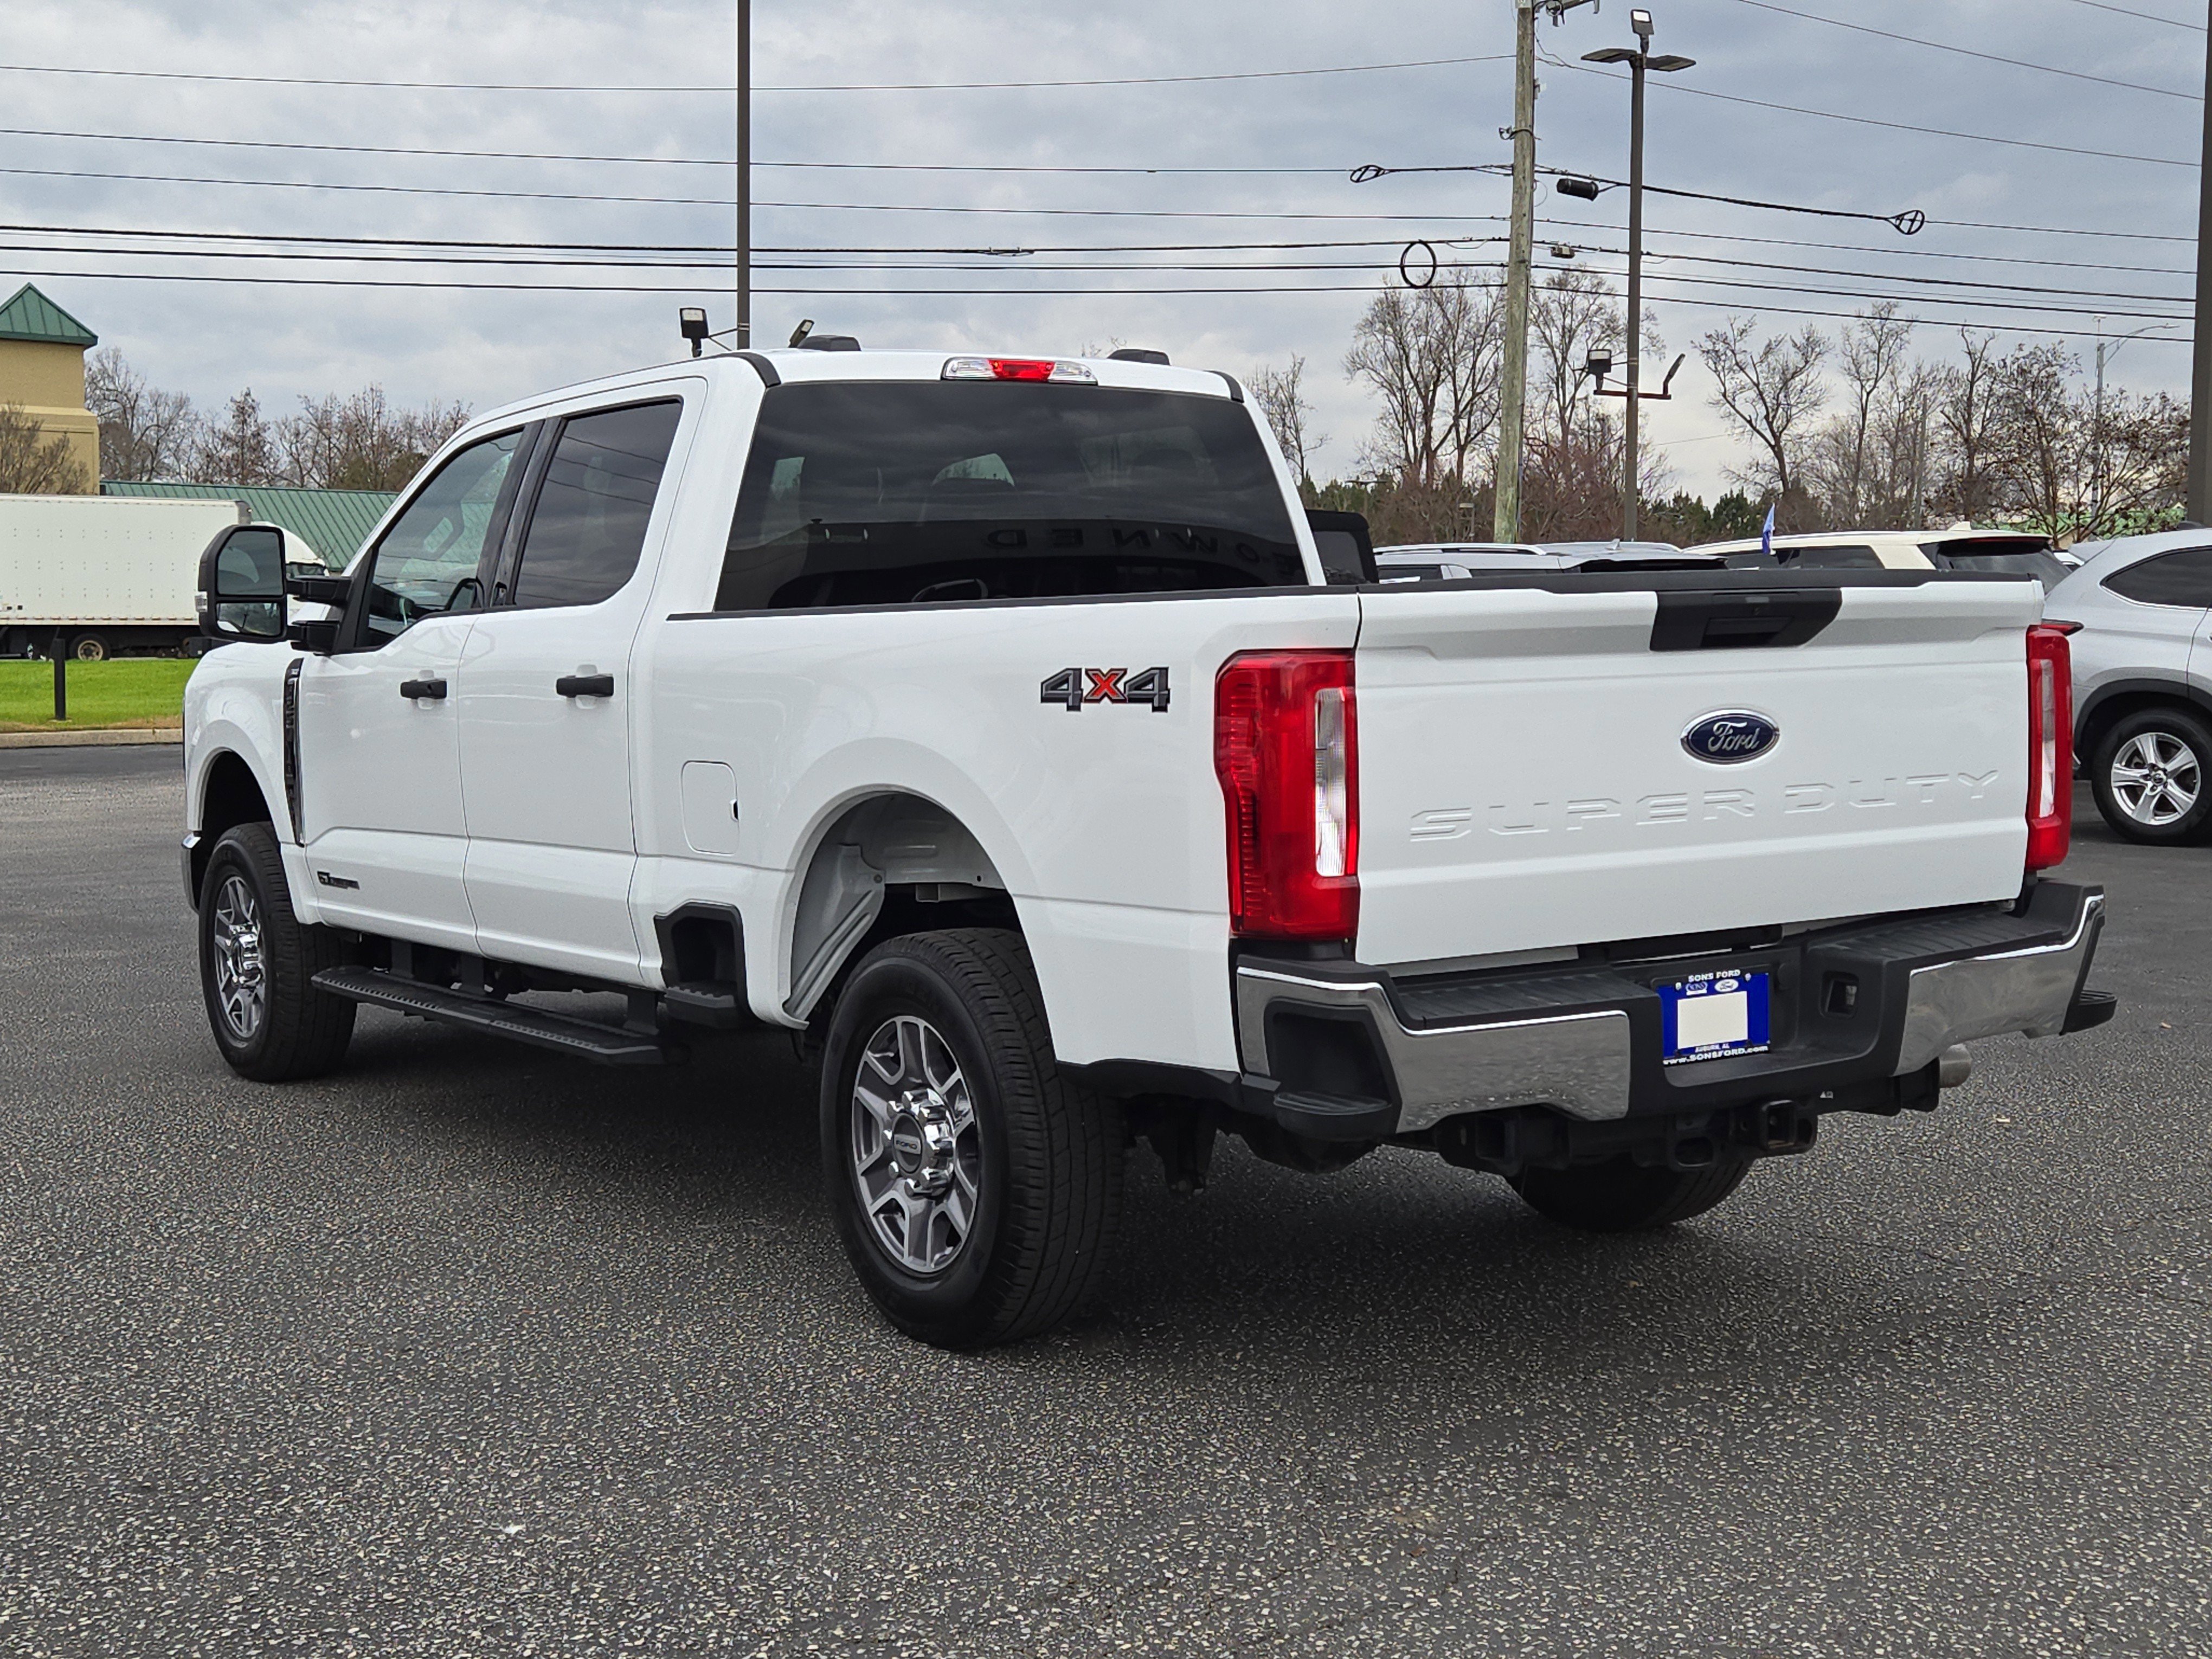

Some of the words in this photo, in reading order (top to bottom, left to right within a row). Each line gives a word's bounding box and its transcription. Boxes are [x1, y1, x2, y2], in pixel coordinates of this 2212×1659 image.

[1708, 721, 1760, 753] Ford
[1410, 788, 1756, 841] SUPER
[1784, 769, 1999, 814] DUTY
[1688, 973, 1714, 983] SONS
[1716, 969, 1741, 979] FORD
